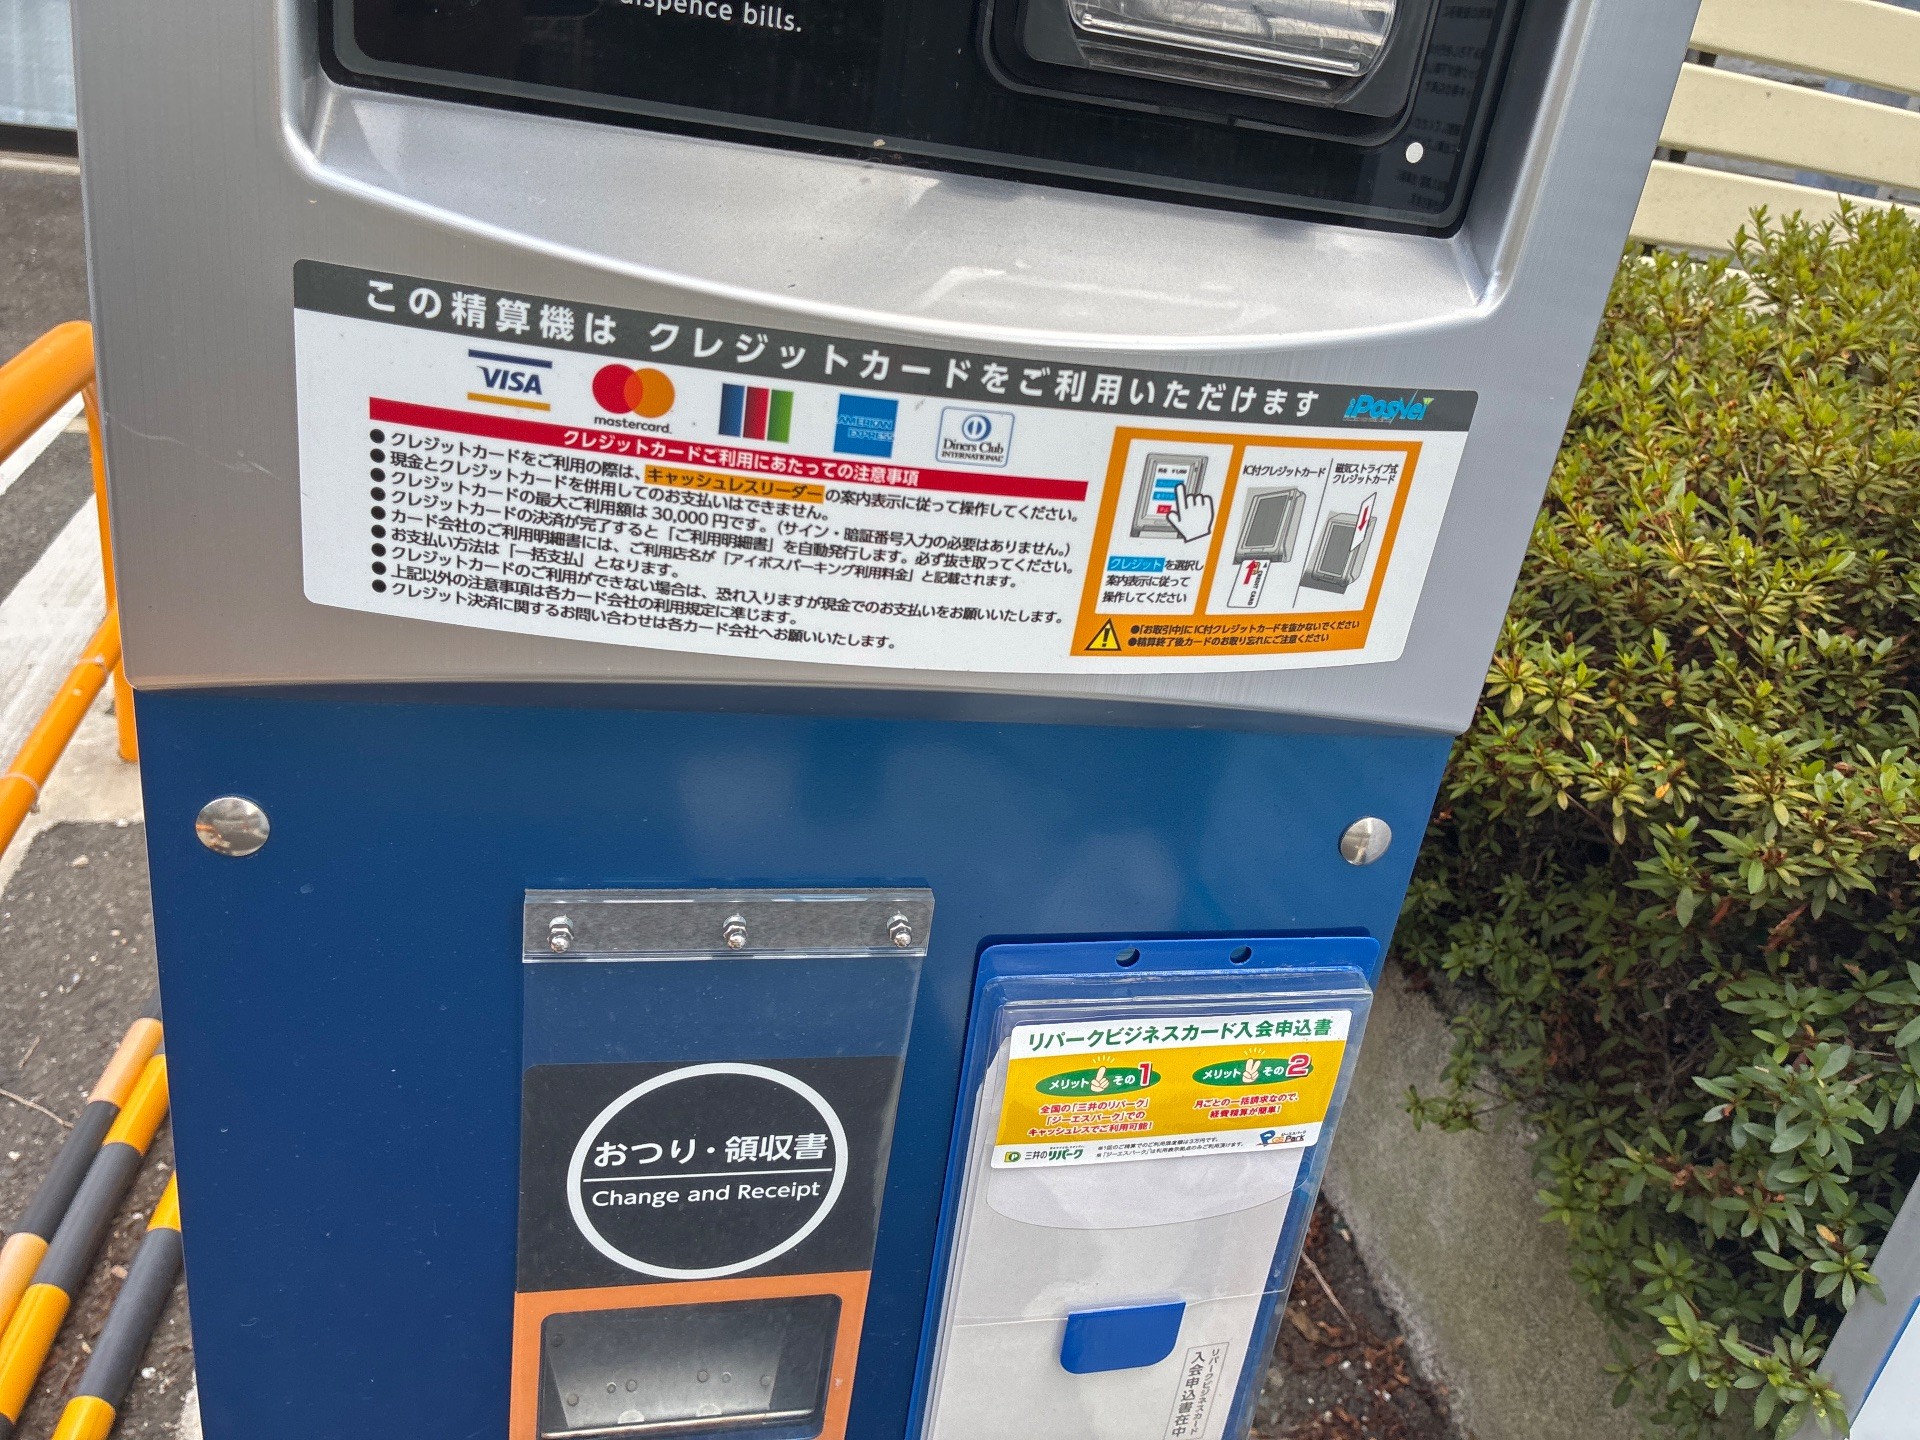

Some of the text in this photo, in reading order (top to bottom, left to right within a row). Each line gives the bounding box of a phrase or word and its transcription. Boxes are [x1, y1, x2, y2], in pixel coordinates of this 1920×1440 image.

[619, 0, 801, 32] pence bills.
[366, 279, 1319, 418] この精算機は クレジットカードをご利用いただけます
[477, 365, 543, 395] VISA
[563, 430, 920, 487] クレジットカードご利用にあたっての注意事項
[943, 438, 1004, 455] Diners Club
[1332, 473, 1396, 485] クレジットカード
[1105, 575, 1191, 588] 案内表示に従って
[1102, 591, 1187, 604] 操作してください
[1028, 1018, 1334, 1051] リパークビジネスカード入会申込書
[1049, 1077, 1089, 1090] メリット
[1203, 1068, 1241, 1080] メリット
[593, 1132, 829, 1168] おつり・領収書
[1024, 1148, 1084, 1161] 三井のリパーク
[592, 1181, 821, 1208] Change and Receipt
[1171, 1351, 1205, 1438] 入会申込書在中
